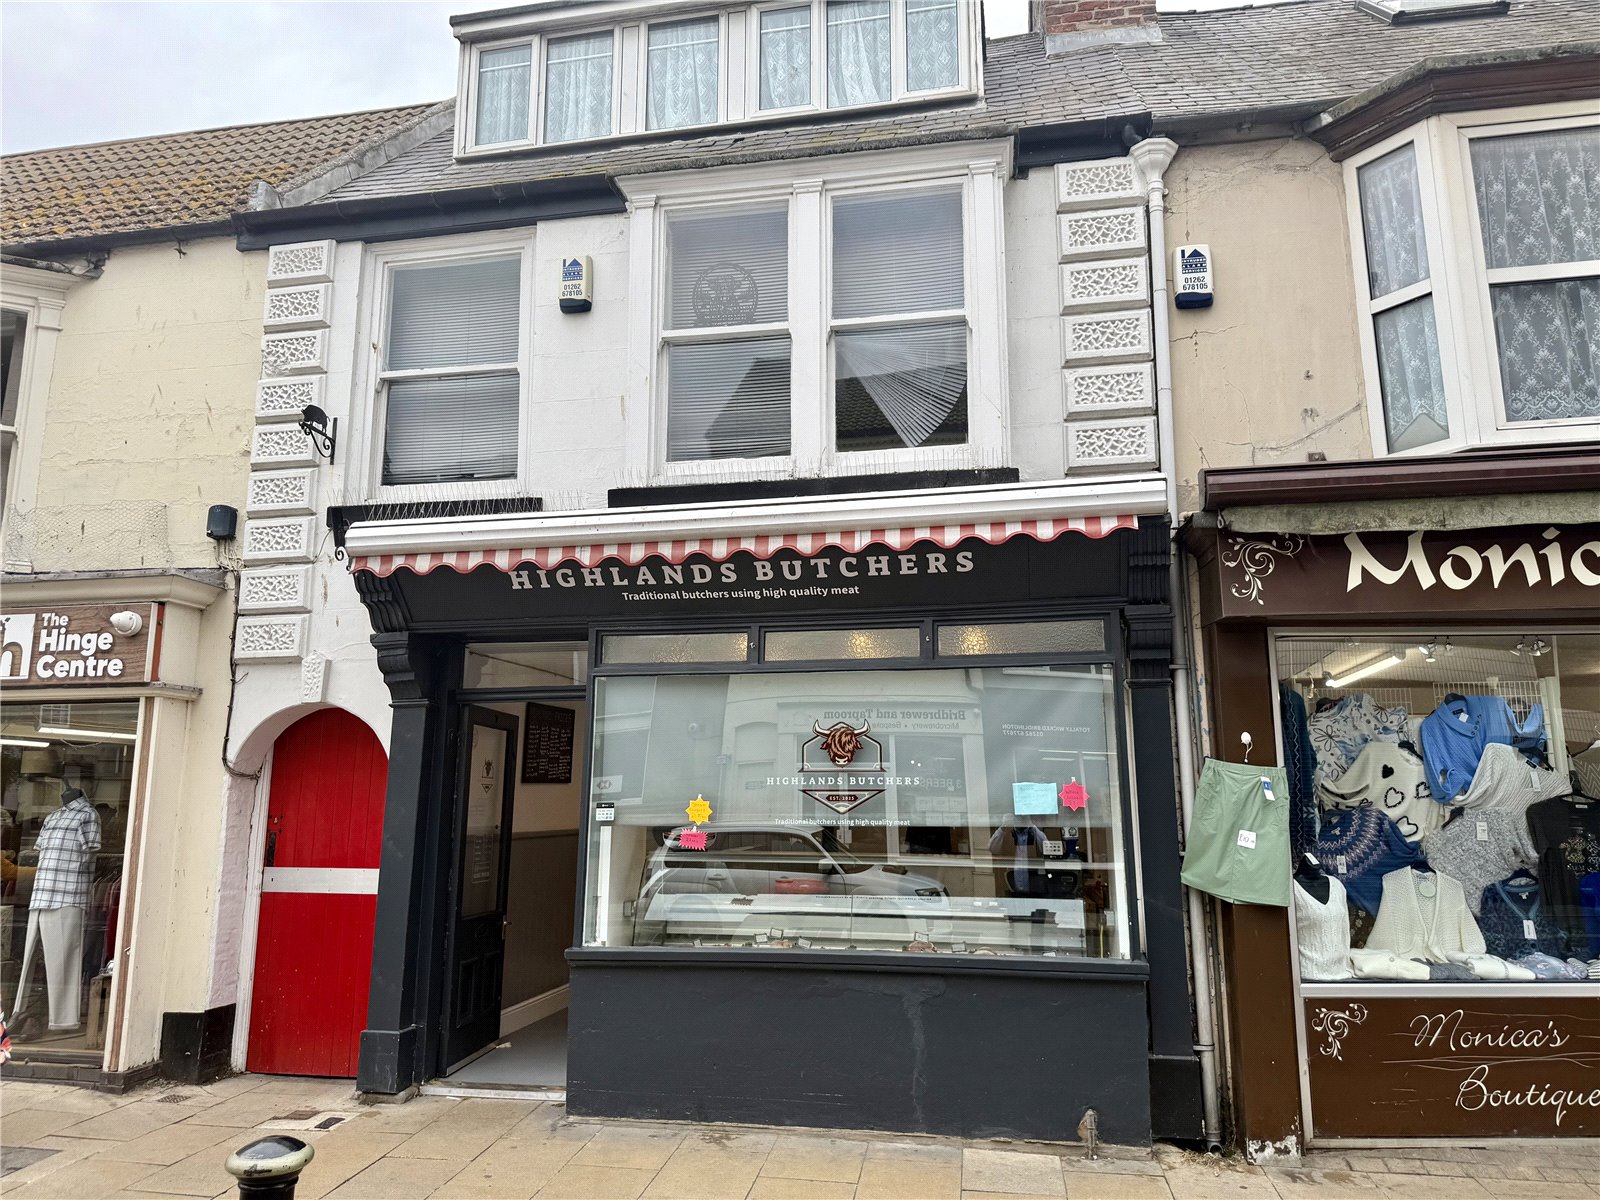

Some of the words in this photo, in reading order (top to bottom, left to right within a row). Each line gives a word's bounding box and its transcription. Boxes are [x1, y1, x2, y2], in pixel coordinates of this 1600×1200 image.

[1182, 283, 1208, 291] 678105
[1184, 276, 1206, 284] 01262
[562, 289, 583, 297] 678105
[508, 563, 738, 590] HIGHLANDS
[753, 551, 975, 581] BUTCHERS
[622, 589, 681, 601] Traditional
[682, 588, 729, 600] butchers
[731, 588, 760, 601] using
[762, 586, 787, 600] high
[789, 585, 829, 599] quality
[831, 584, 860, 596] meat
[42, 613, 69, 626] The
[39, 627, 113, 656] Hinge
[36, 655, 123, 678] Centre
[766, 777, 844, 785] HIGHLANDS
[849, 777, 920, 785] BUTCHERS
[837, 818, 855, 827] using
[855, 818, 870, 826] high
[870, 818, 893, 827] quality
[1410, 1009, 1570, 1051] Monica's
[1455, 1064, 1600, 1127] Boutique
